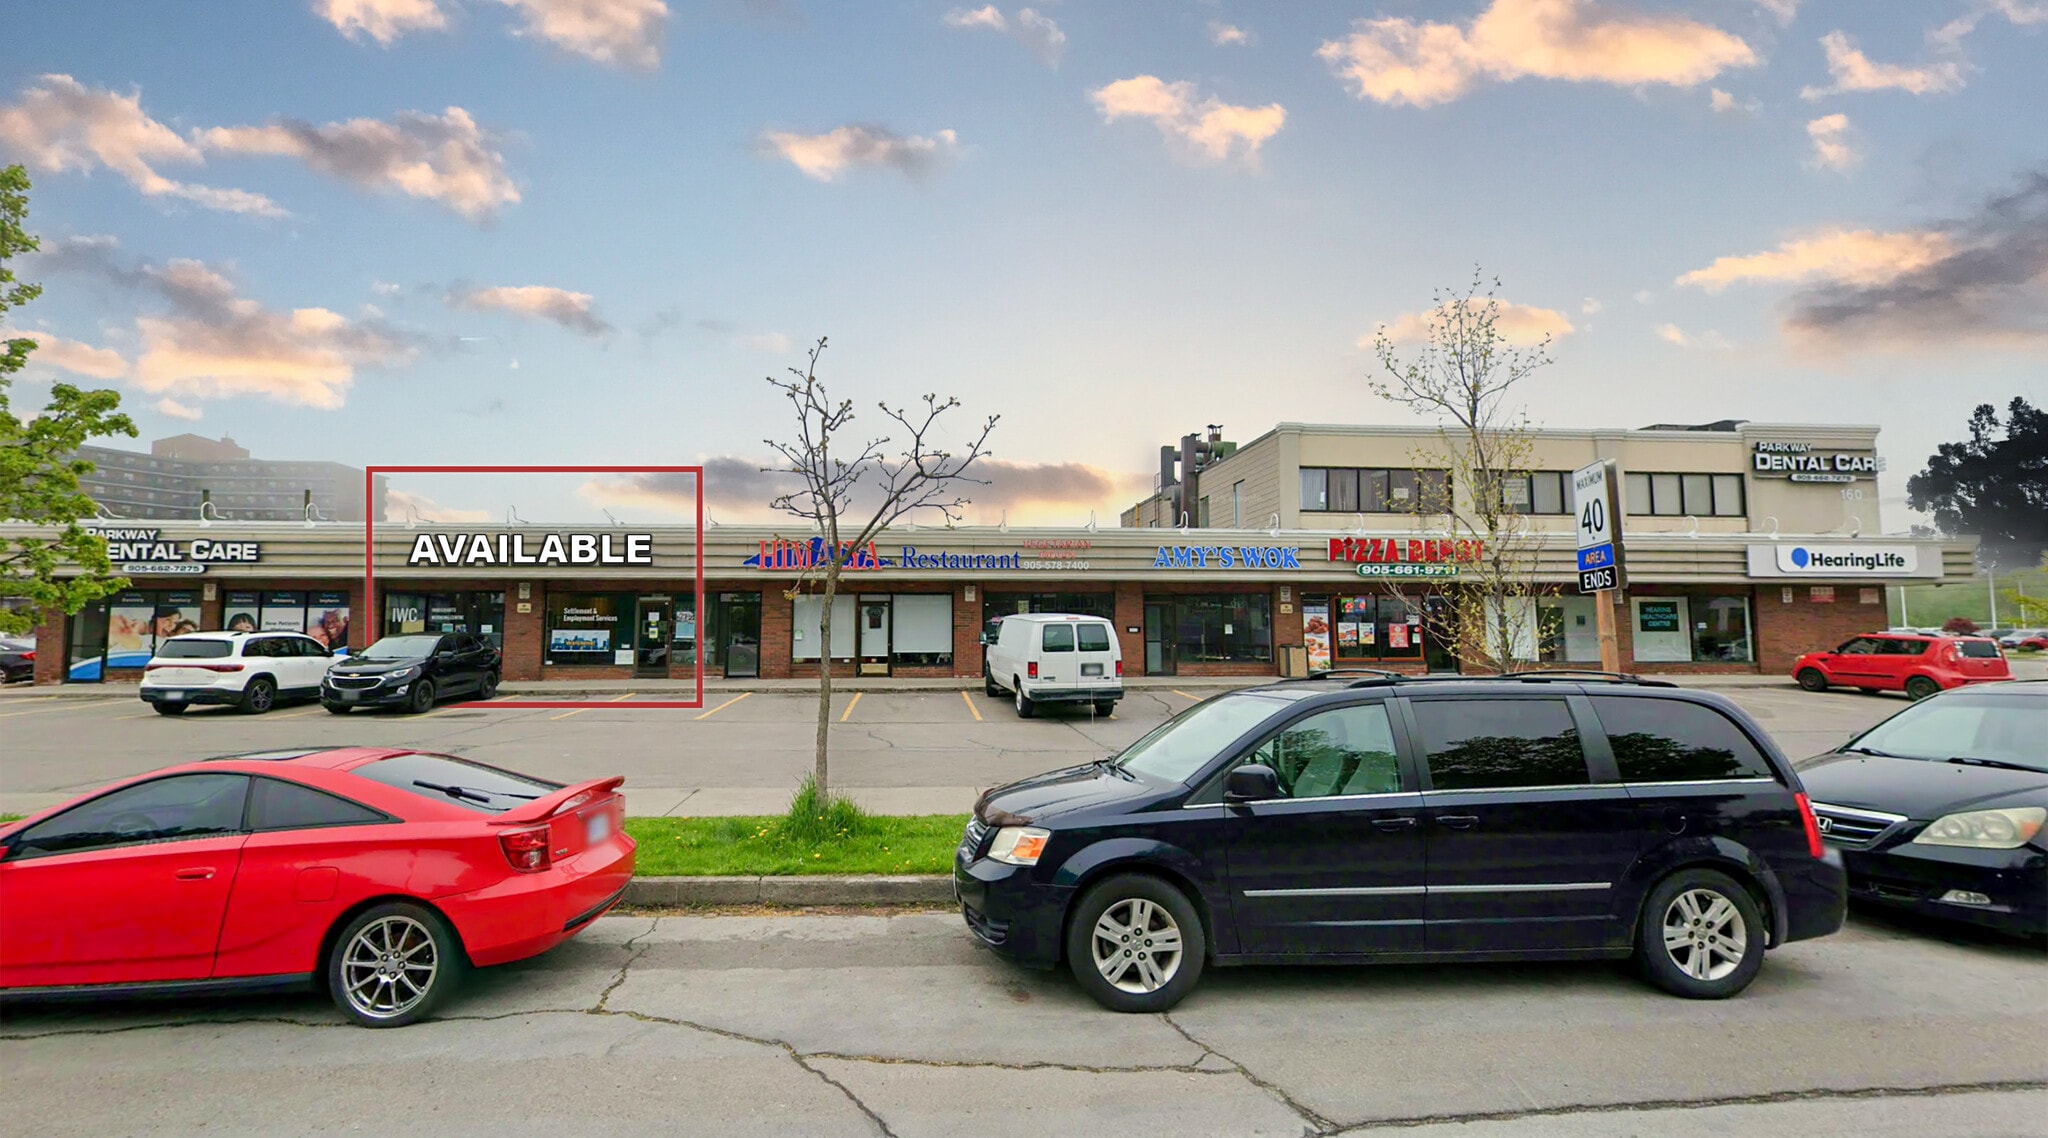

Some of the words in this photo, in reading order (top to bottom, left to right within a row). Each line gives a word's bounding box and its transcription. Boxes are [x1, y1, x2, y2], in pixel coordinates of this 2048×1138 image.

[1759, 442, 1813, 452] PARKWAY
[1755, 453, 1831, 471] DENTAL
[1576, 471, 1602, 491] MAXIMUM
[1841, 488, 1862, 500] 160
[1582, 498, 1604, 534] 40
[106, 543, 182, 560] ENTAL
[190, 540, 257, 560] CARE
[902, 546, 1021, 570] Restaurant
[1154, 546, 1235, 568] AMY'S
[1239, 546, 1300, 568] WOK
[1585, 550, 1607, 565] AREA
[1023, 561, 1090, 570] 905-578-7400
[1362, 565, 1457, 575] 905-661-9711
[1811, 553, 1905, 570] HearingLife
[1584, 570, 1613, 589] ENDS
[392, 607, 418, 623] IWC
